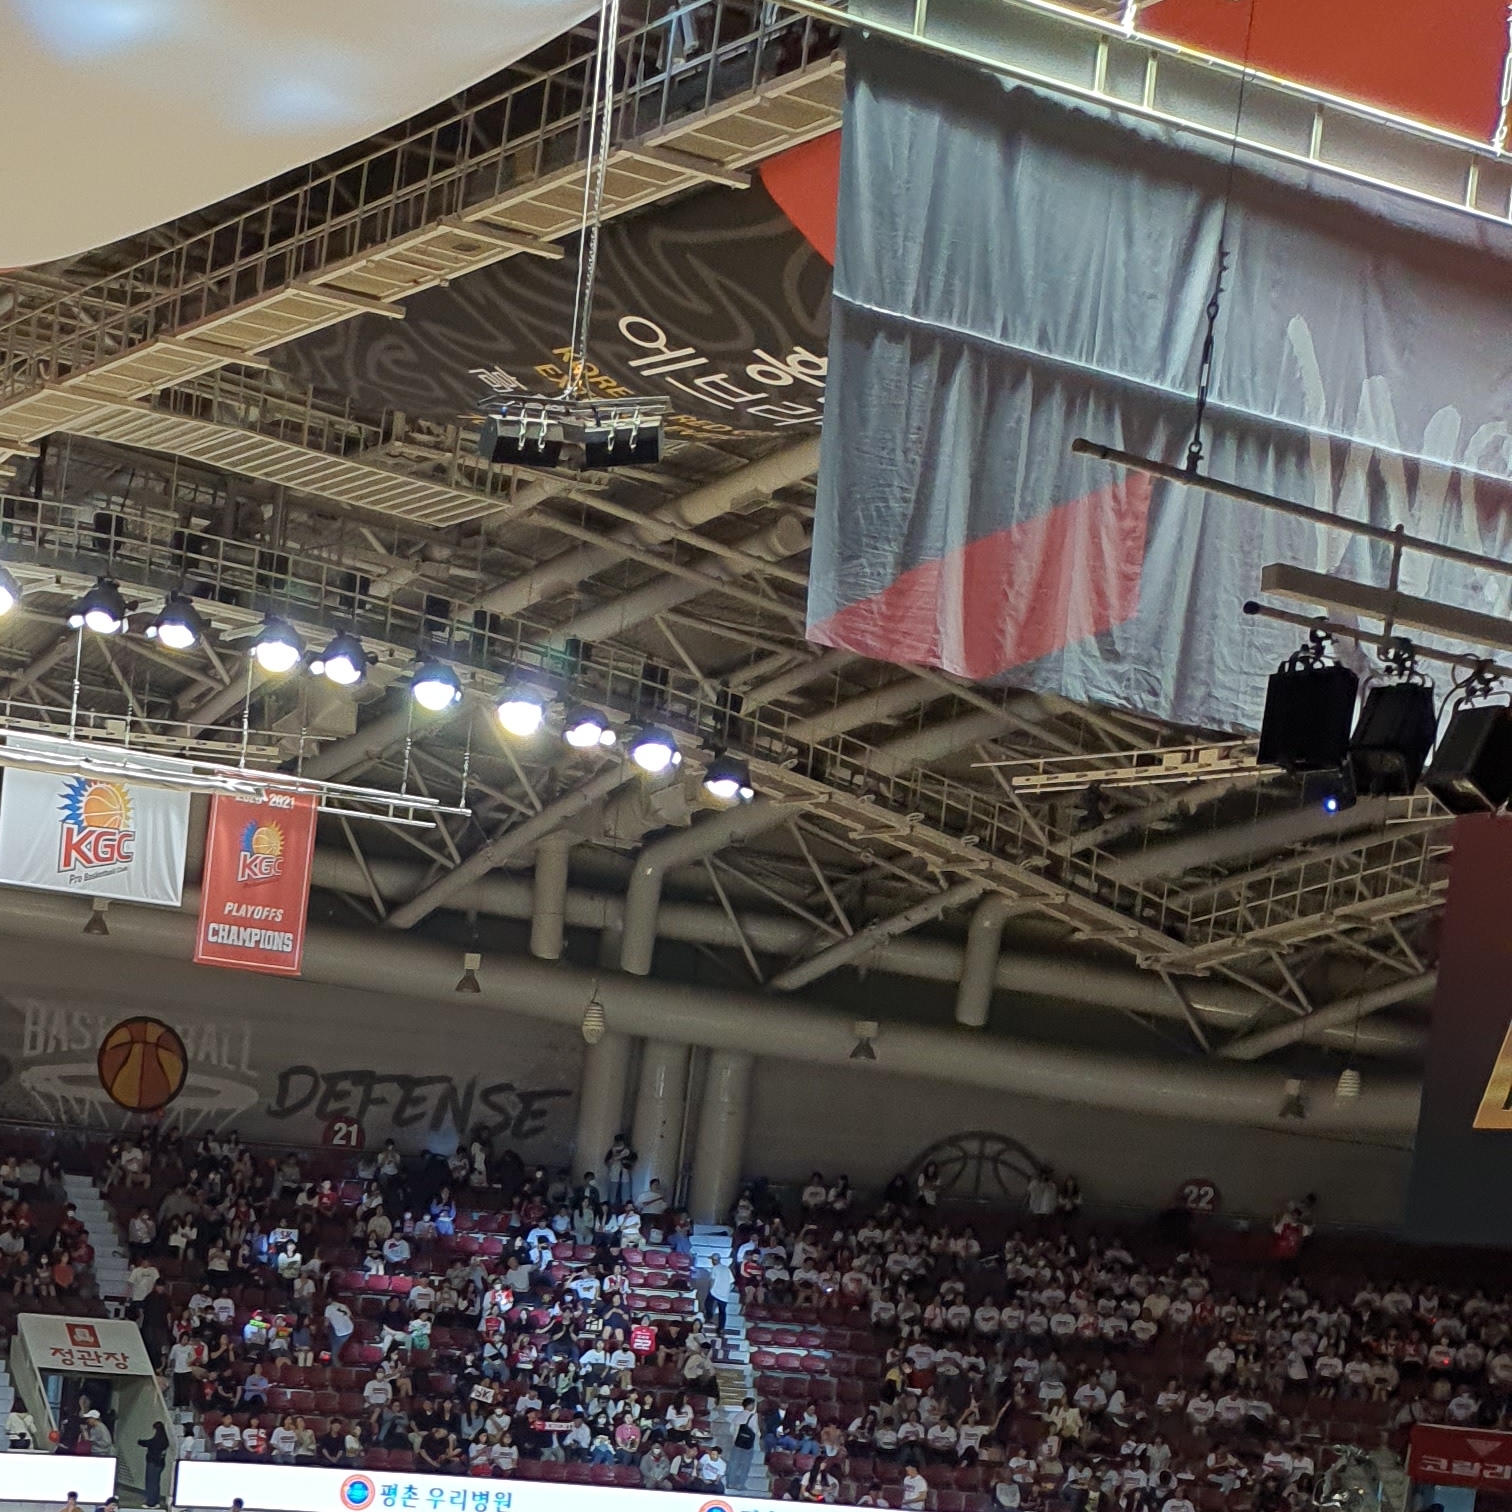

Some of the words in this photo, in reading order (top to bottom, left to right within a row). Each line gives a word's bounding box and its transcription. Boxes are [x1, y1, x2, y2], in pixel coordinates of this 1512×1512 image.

[58, 821, 136, 873] KGC
[238, 851, 284, 882] KGC
[223, 902, 284, 922] PLAYOFFS
[207, 923, 294, 952] CHAMPIONS
[268, 1064, 572, 1141] DEFENSE
[332, 1123, 358, 1147] 21
[1184, 1186, 1215, 1212] 22
[50, 1347, 130, 1370] 정관장
[380, 1484, 420, 1508] 평촌
